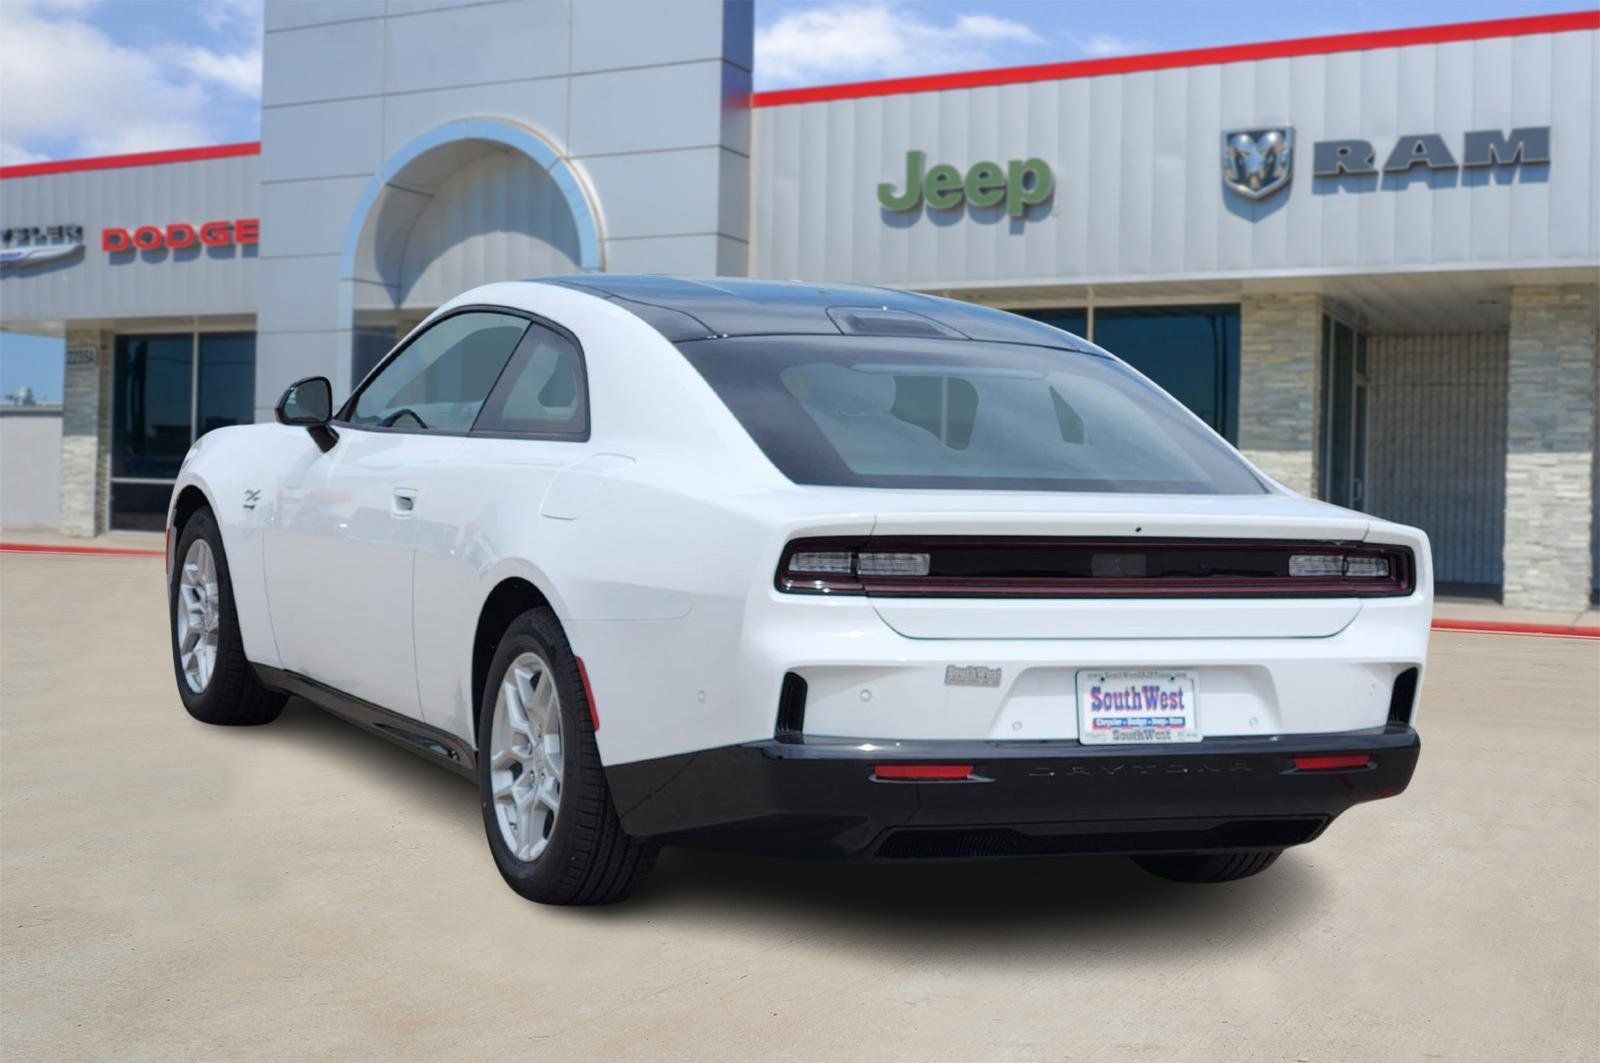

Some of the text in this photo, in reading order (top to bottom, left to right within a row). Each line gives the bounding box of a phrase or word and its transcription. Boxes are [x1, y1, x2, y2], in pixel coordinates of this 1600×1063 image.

[1313, 126, 1551, 175] RAM
[877, 151, 1056, 217] Jeep
[102, 218, 260, 251] DODGE
[1091, 686, 1185, 711] SouthWest
